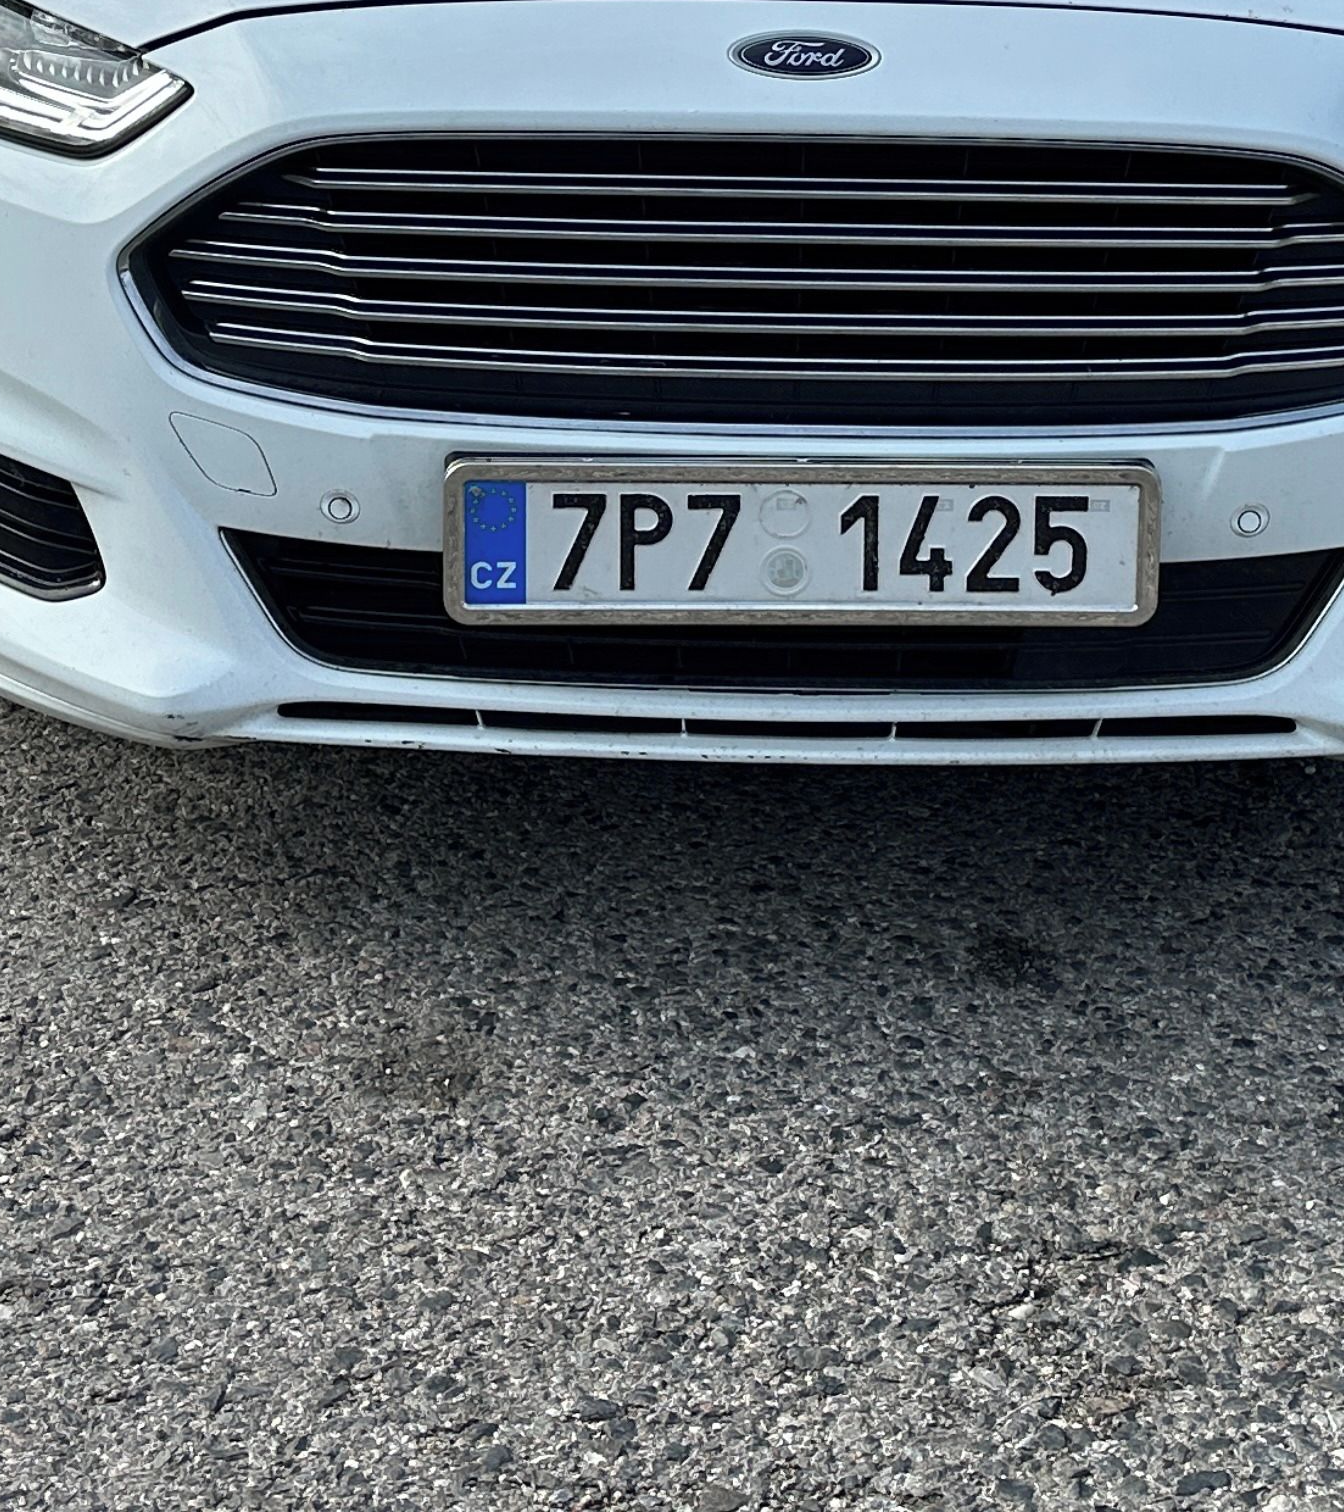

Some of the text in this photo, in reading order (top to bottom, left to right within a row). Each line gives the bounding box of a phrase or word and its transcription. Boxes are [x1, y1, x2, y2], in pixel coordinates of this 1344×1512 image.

[764, 40, 846, 67] Ford
[551, 493, 1088, 594] 7P7 1425
[470, 561, 518, 589] CZ
